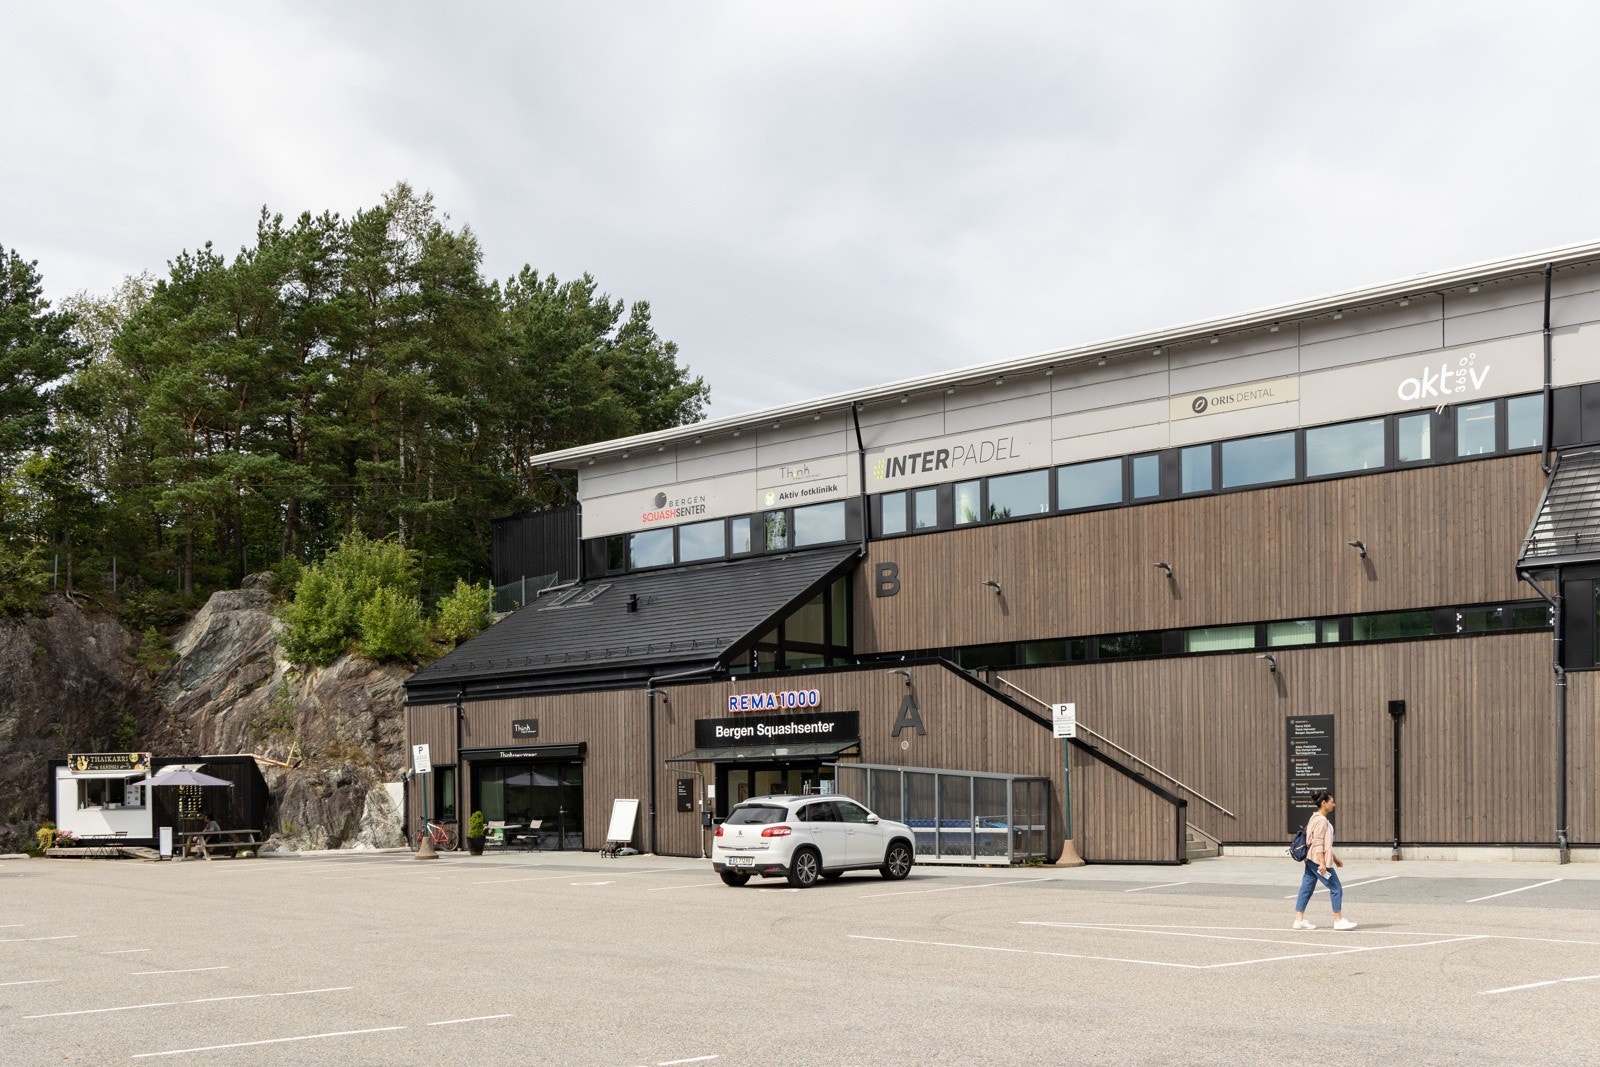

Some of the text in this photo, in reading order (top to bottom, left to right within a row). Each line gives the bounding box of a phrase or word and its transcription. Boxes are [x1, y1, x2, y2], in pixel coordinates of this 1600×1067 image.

[1211, 388, 1275, 406] ORIS DENTAL
[779, 484, 838, 500] Aktiv fotklinikk
[668, 495, 706, 507] BERGEN
[875, 562, 901, 598] B
[728, 689, 819, 712] REMA 1000
[891, 694, 926, 737] A
[1060, 705, 1067, 716] P
[715, 722, 835, 739] Bergen Squashsenter
[418, 746, 424, 754] P
[90, 755, 129, 763] THAIKARRI
